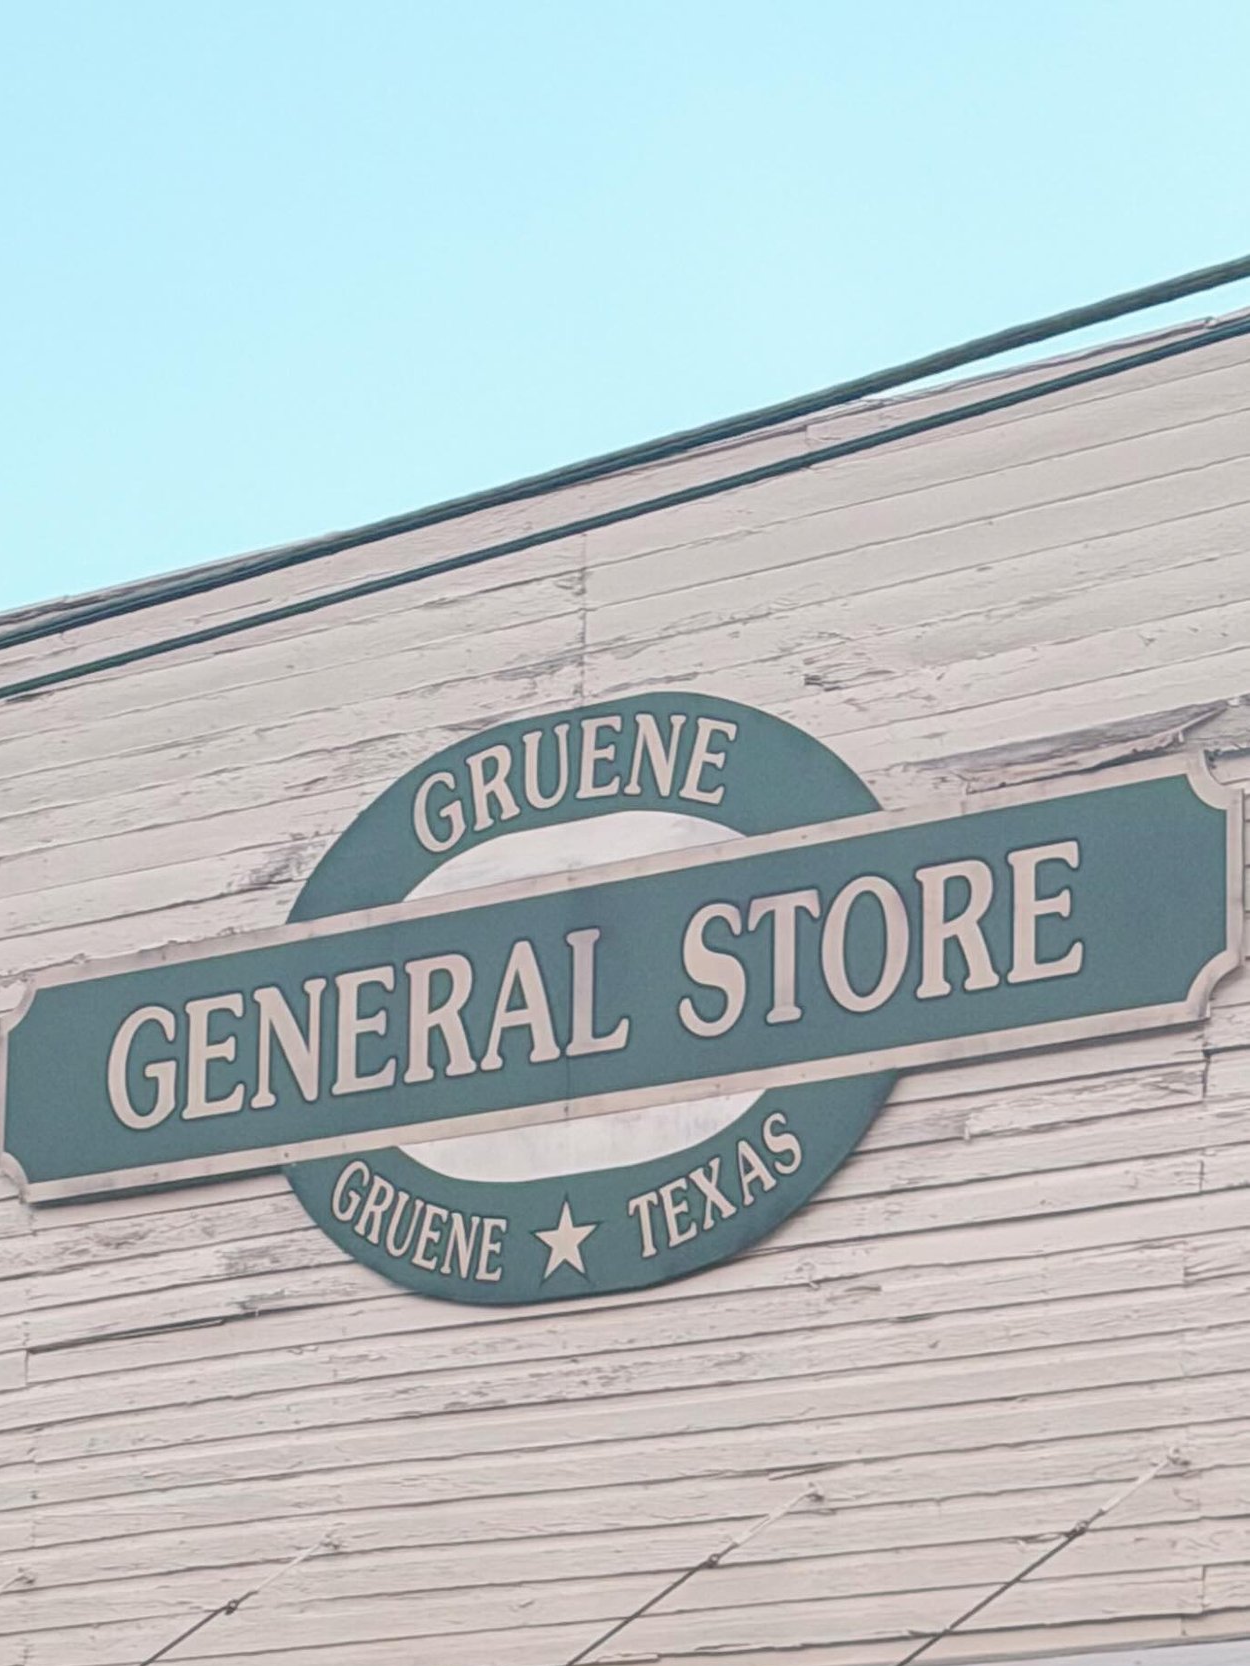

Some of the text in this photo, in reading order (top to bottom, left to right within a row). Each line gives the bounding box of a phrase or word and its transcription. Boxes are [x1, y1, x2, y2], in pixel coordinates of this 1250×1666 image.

[410, 712, 739, 855] GRUENE
[106, 840, 1086, 1130] GENERAL STORE
[331, 1112, 804, 1285] GRUENE TEXAS
